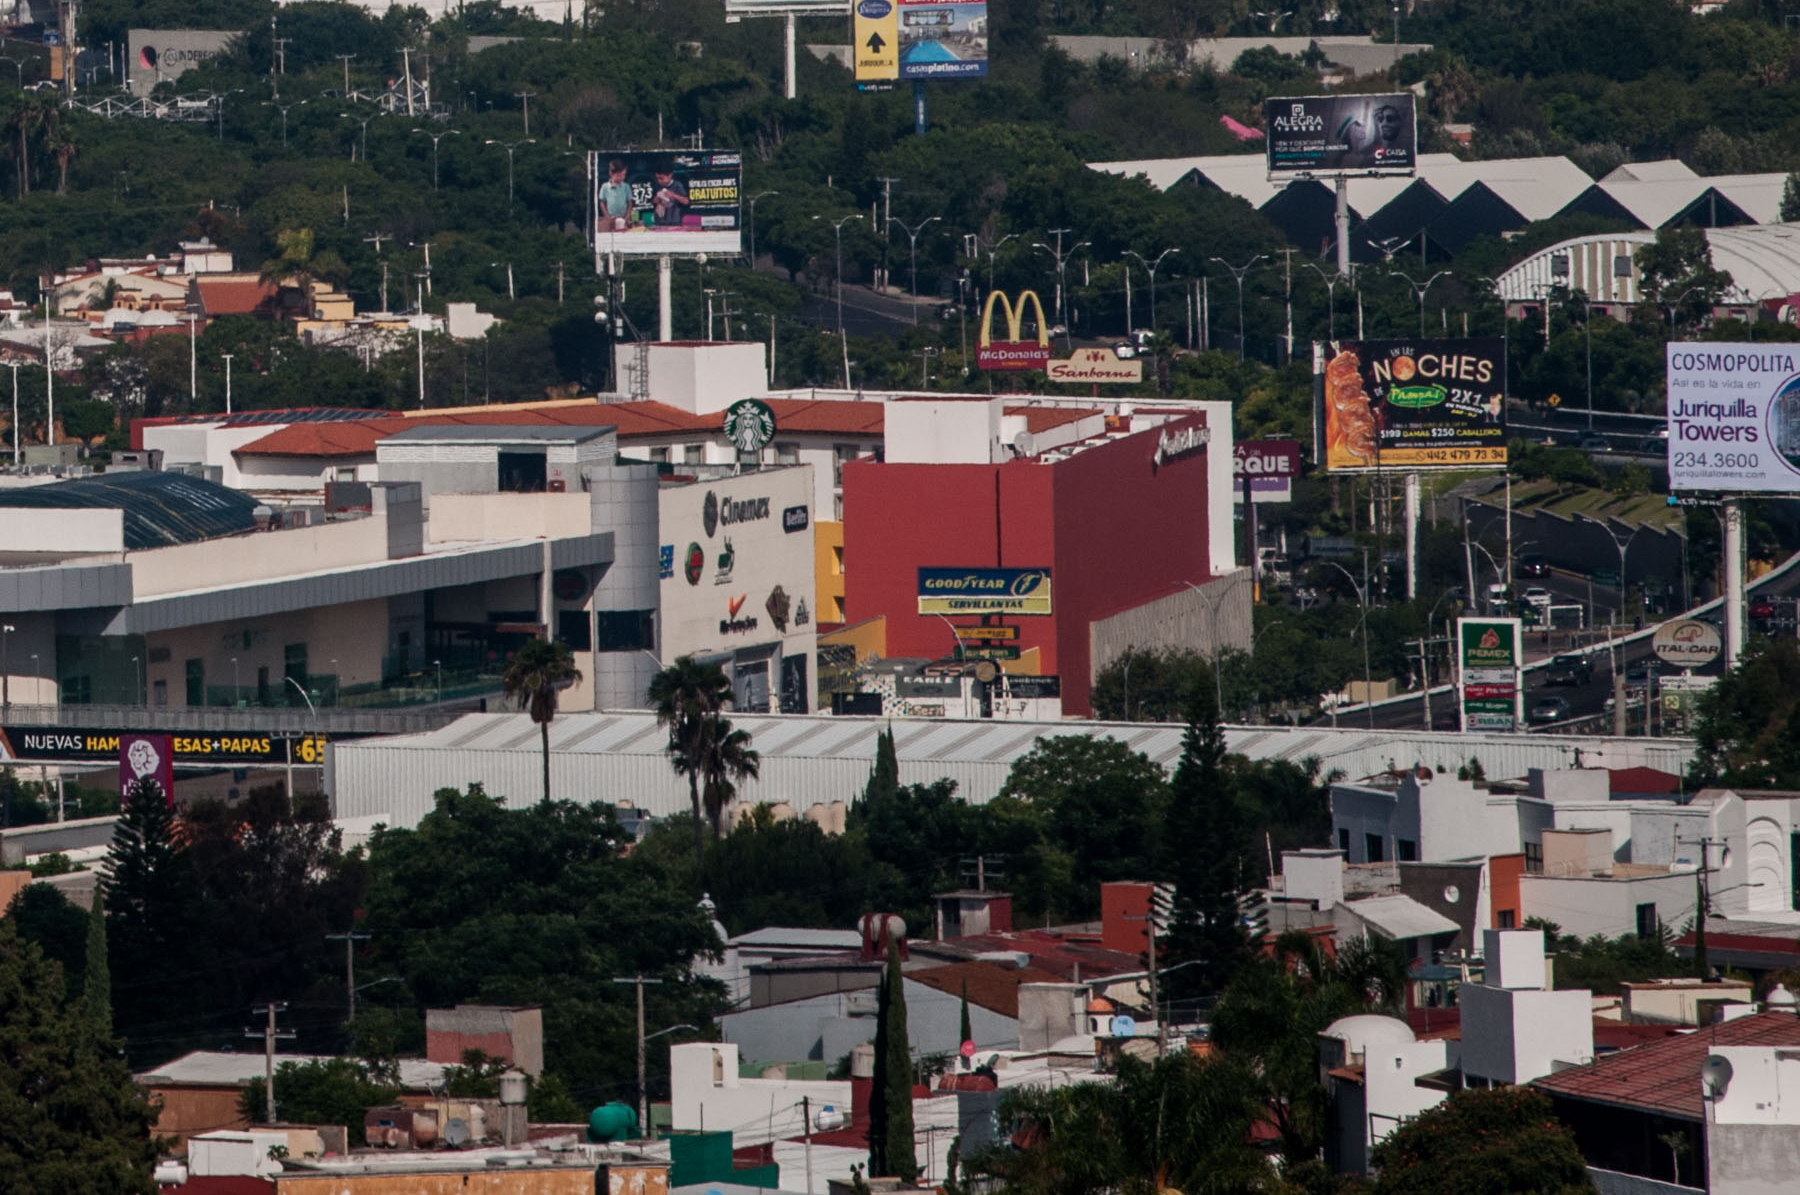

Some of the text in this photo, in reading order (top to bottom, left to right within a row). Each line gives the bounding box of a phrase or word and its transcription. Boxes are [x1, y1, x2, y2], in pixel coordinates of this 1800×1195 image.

[906, 63, 980, 73] casasplatino.com
[1274, 115, 1323, 127] ALEGRA
[980, 350, 1049, 360] McDonald's
[1390, 346, 1415, 357] EN LAS
[1672, 354, 1794, 372] COSMOPOLITA
[1052, 365, 1137, 379] Sanborns
[1372, 355, 1493, 383] NOCHES
[1692, 380, 1706, 388] es
[1709, 378, 1719, 388] la
[1722, 378, 1744, 388] vida
[1746, 380, 1761, 389] en
[1672, 398, 1757, 421] Juriquilla
[1402, 429, 1429, 437] DAMAS
[1431, 428, 1454, 437] $250
[1456, 428, 1502, 436] CABALLEROS
[1672, 419, 1758, 442] Towers
[1427, 449, 1504, 460] 442 479 73 34
[1674, 452, 1759, 468] 234.3600
[1674, 469, 1766, 479] juriquillatowers.com
[925, 576, 1006, 589] GOODYEAR
[949, 599, 1023, 608] SERVILLANTAS
[1468, 649, 1510, 658] PEMEX
[24, 734, 82, 749] NUEVAS
